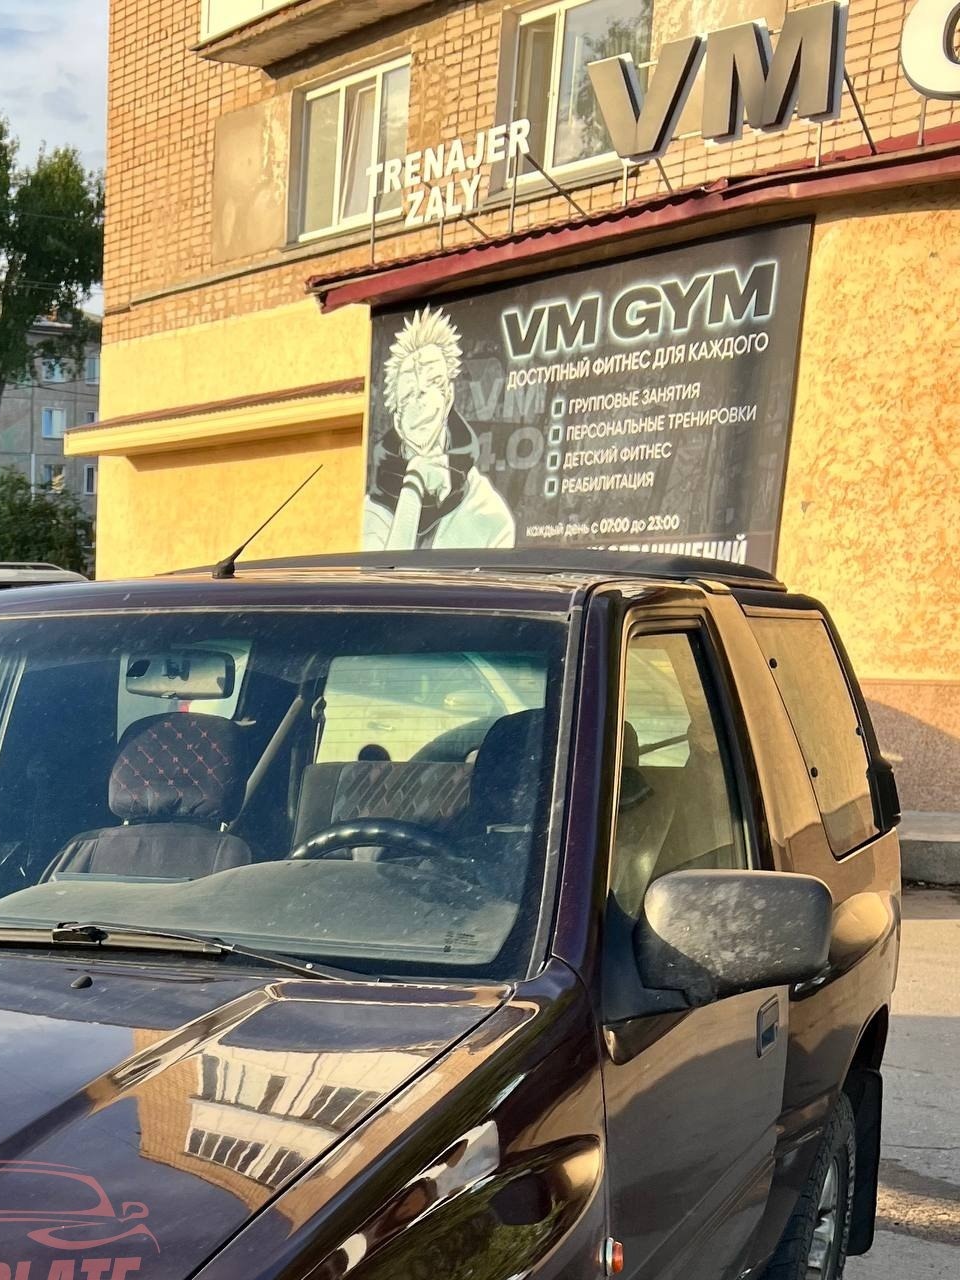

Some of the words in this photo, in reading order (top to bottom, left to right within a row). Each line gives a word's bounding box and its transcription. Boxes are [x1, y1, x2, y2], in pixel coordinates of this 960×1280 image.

[588, 0, 848, 163] VM
[366, 118, 531, 198] TRENAJER
[404, 173, 481, 228] ZALY
[502, 295, 600, 359] VM
[610, 261, 778, 342] GYM
[507, 356, 590, 391] ДОСТУПНЫЙ
[592, 351, 651, 376] ФИТНЕС
[652, 343, 685, 370] ДЛЯ
[688, 332, 769, 362] КАЖДОГО
[569, 391, 640, 415] ГРУППОВЫЕ
[642, 382, 701, 404] ЗАНЯТИЯ
[566, 414, 665, 442] ПЕРСОНАЛЬНЫЕ
[668, 404, 757, 431] ТРЕНИРОВКИ
[563, 446, 617, 470] ДЕТСКИЙ
[620, 442, 673, 461] ФИТНЕС
[561, 471, 655, 494] РЕАБИЛИТАЦИЯ
[591, 522, 599, 534] с
[599, 517, 630, 534] 07:00
[630, 519, 646, 534] до
[647, 514, 680, 531] 23:00
